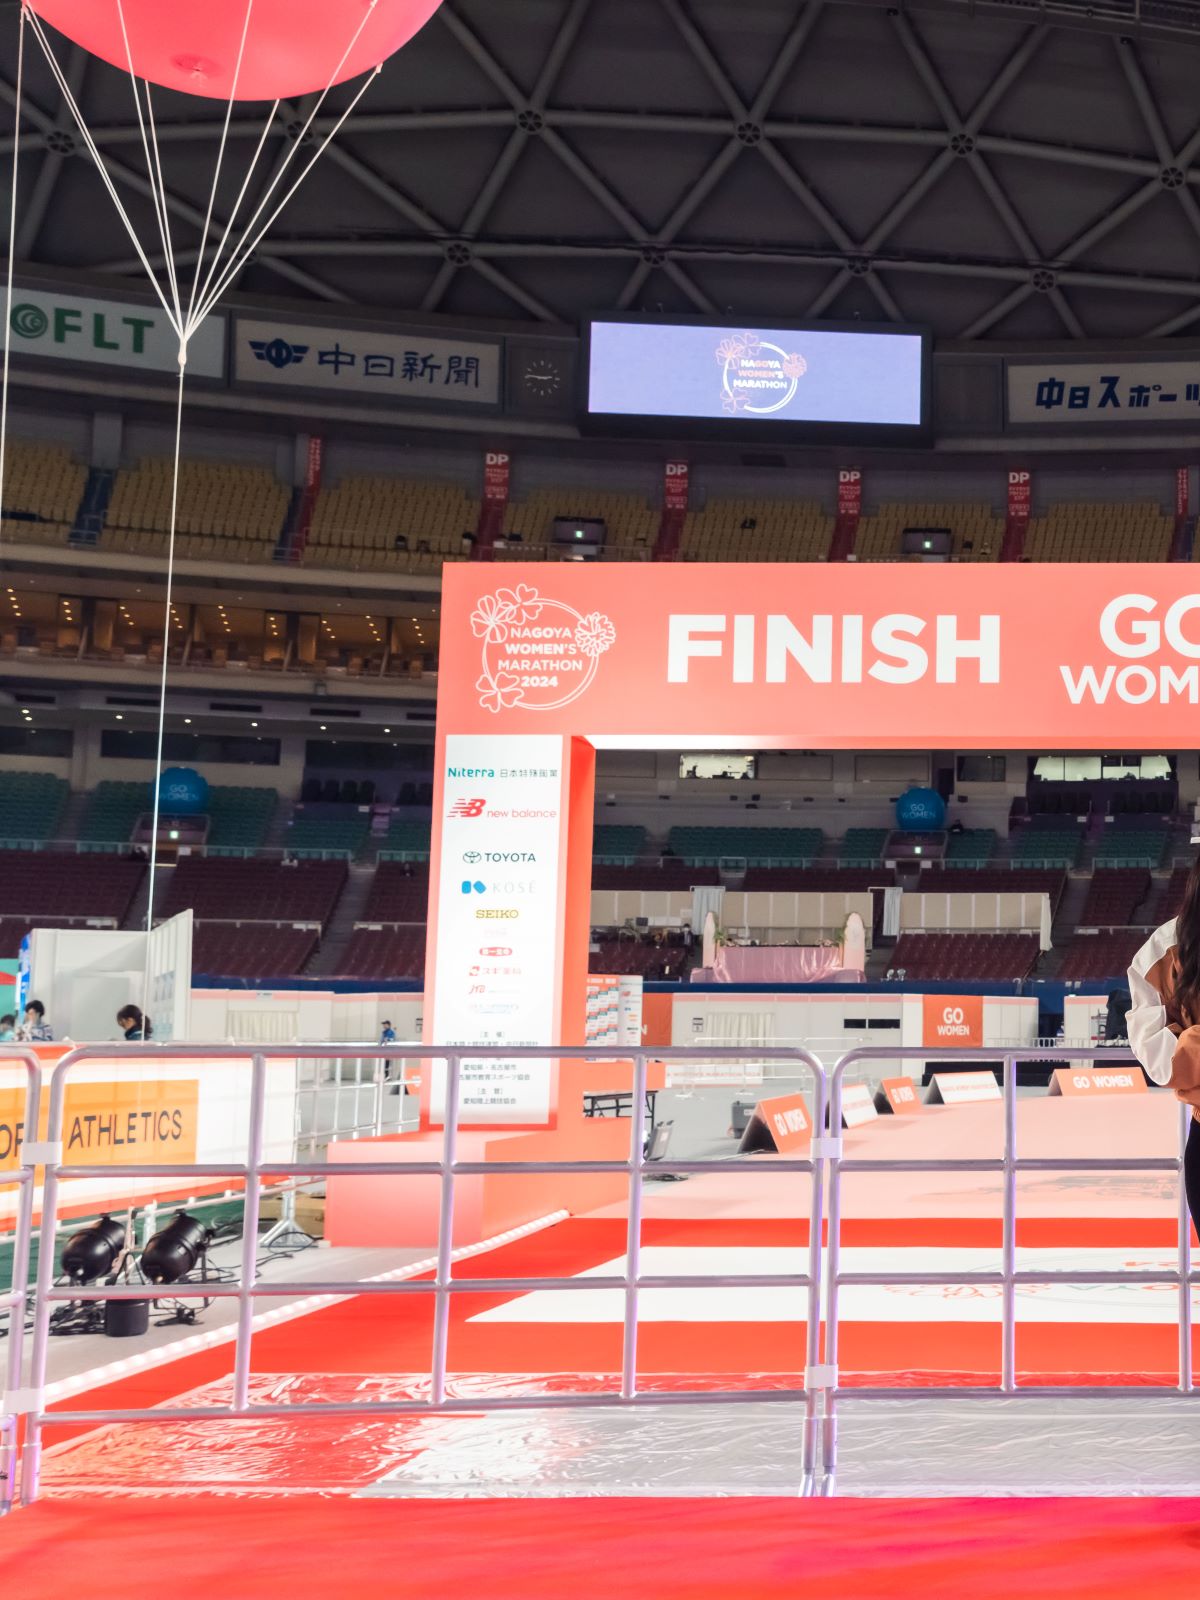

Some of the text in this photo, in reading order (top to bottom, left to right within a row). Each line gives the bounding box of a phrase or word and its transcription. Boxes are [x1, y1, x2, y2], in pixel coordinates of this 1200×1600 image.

[52, 308, 154, 354] FLT
[317, 342, 480, 388] 中日新聞
[741, 359, 781, 369] NAGOYA
[733, 379, 788, 389] MARATHON
[486, 453, 509, 465] DP
[665, 463, 687, 476] DP
[839, 470, 861, 483] DP
[1009, 471, 1030, 483] DP
[510, 627, 572, 638] NAGOYA
[505, 643, 577, 655] WOMEN'S
[667, 613, 1000, 685] FINISH
[498, 659, 582, 671] MARATHON
[521, 676, 558, 687] 2024
[447, 767, 495, 778] Niterra
[169, 784, 188, 793] GO
[910, 803, 925, 811] GO
[486, 810, 508, 818] new
[512, 809, 557, 818] balance
[901, 811, 937, 819] WOMEN
[485, 853, 536, 862] TOYOTA
[475, 909, 519, 919] SEIKO
[943, 1007, 964, 1025] GO
[937, 1024, 970, 1036] WOMEN
[1073, 1075, 1133, 1089] GO WOMEN
[68, 1109, 182, 1150] ATHLETICS
